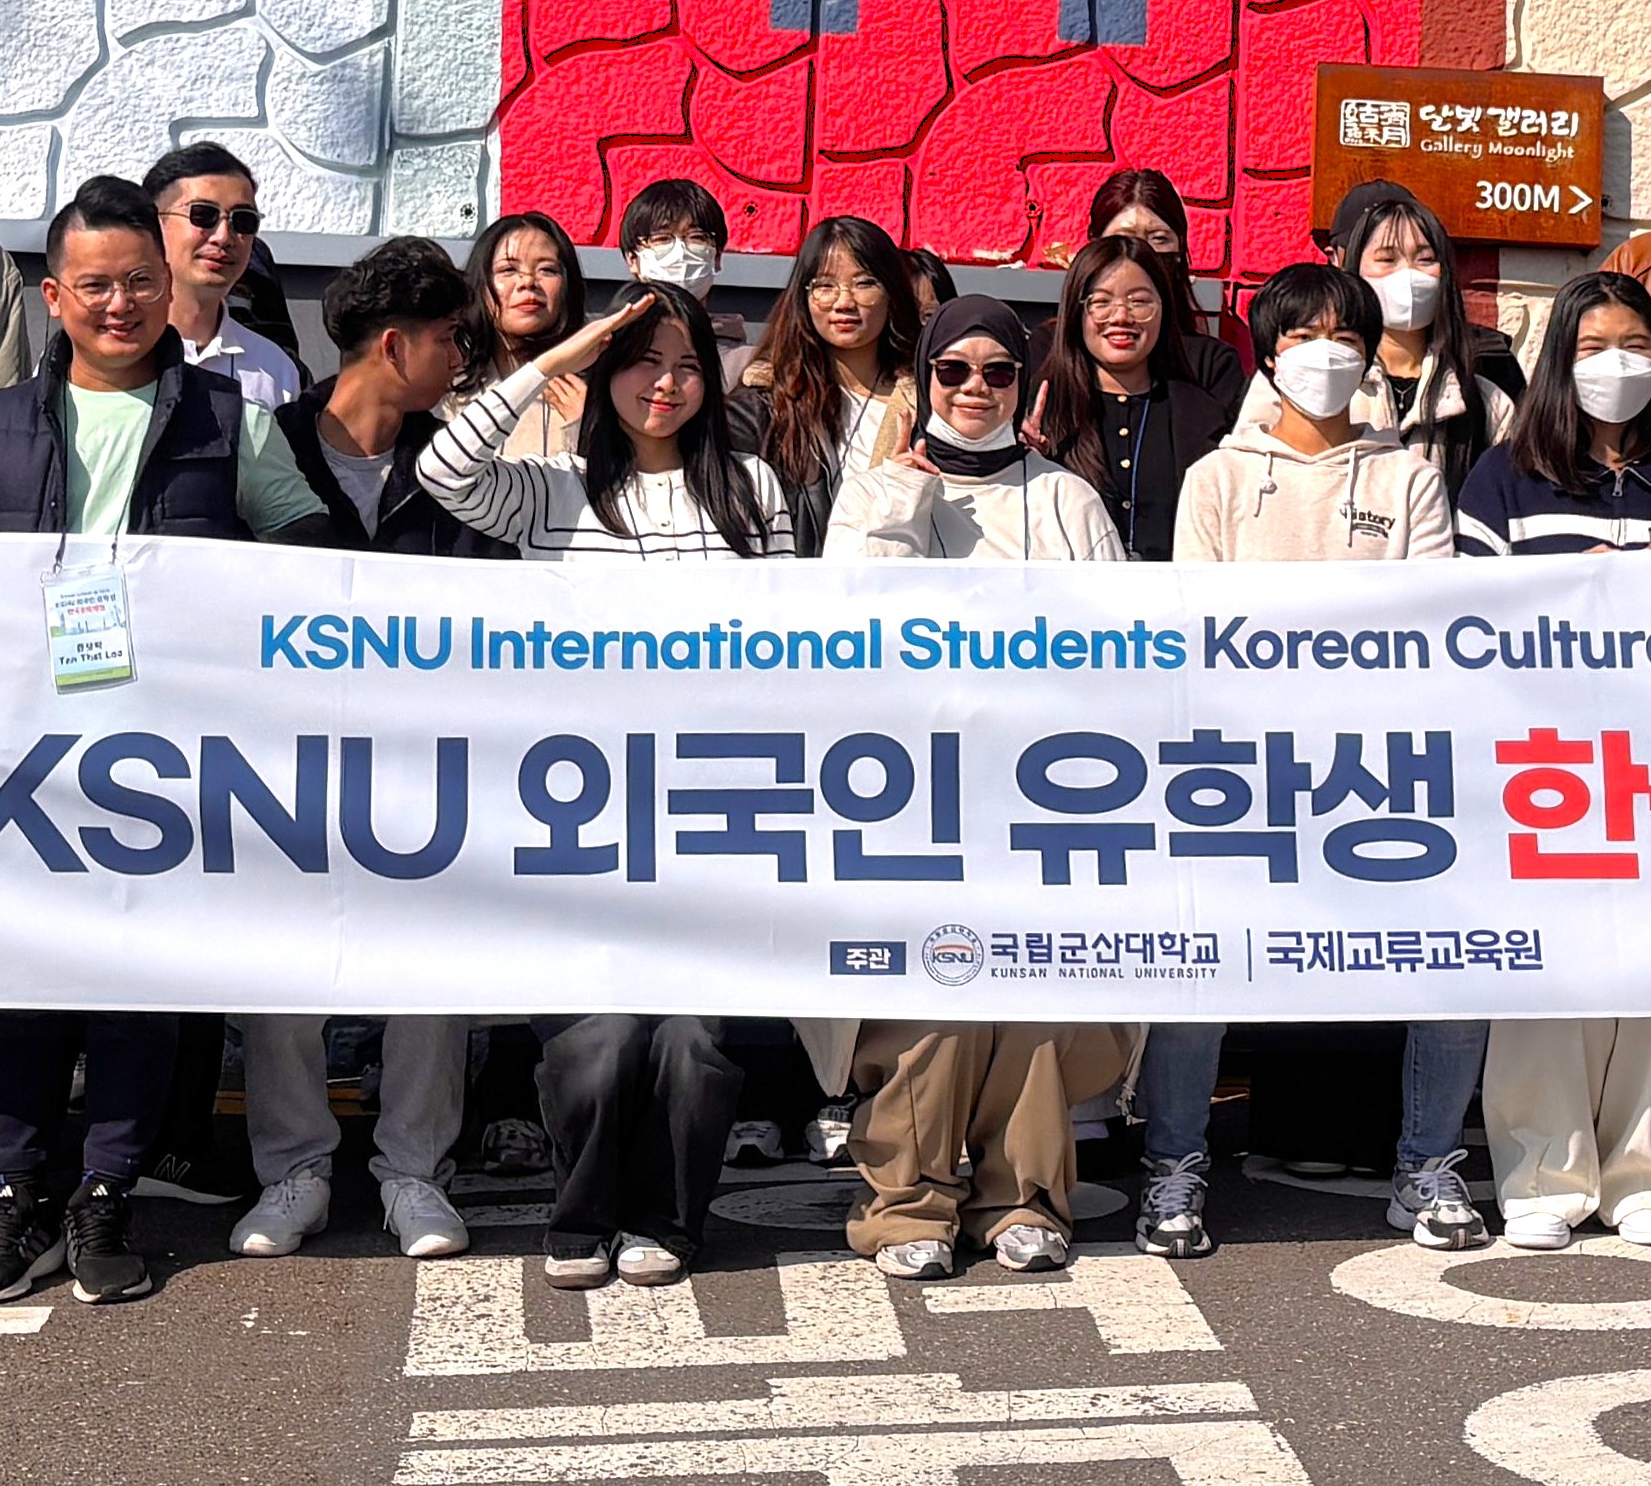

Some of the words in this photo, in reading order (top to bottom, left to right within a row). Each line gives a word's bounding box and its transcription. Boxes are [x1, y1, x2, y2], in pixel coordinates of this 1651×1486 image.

[1419, 103, 1482, 133] 달빛
[1486, 105, 1579, 138] 갤러리
[1420, 135, 1483, 159] Gallery
[1488, 140, 1574, 164] Moonlight
[1475, 181, 1560, 213] 300M
[260, 614, 452, 671] KSNU
[470, 616, 883, 671] International
[899, 616, 1187, 671] Students
[1204, 615, 1431, 670] Korean
[513, 731, 964, 884] 외국인
[1009, 729, 1458, 886] 유학생
[845, 946, 891, 970] 주관
[990, 931, 1221, 965] 국립군산대학교
[1266, 928, 1544, 974] 국제교류교육원
[990, 967, 1048, 979] KUNSAN
[1058, 967, 1125, 979] NATIONAL
[1134, 967, 1217, 980] UNIVERSITY
